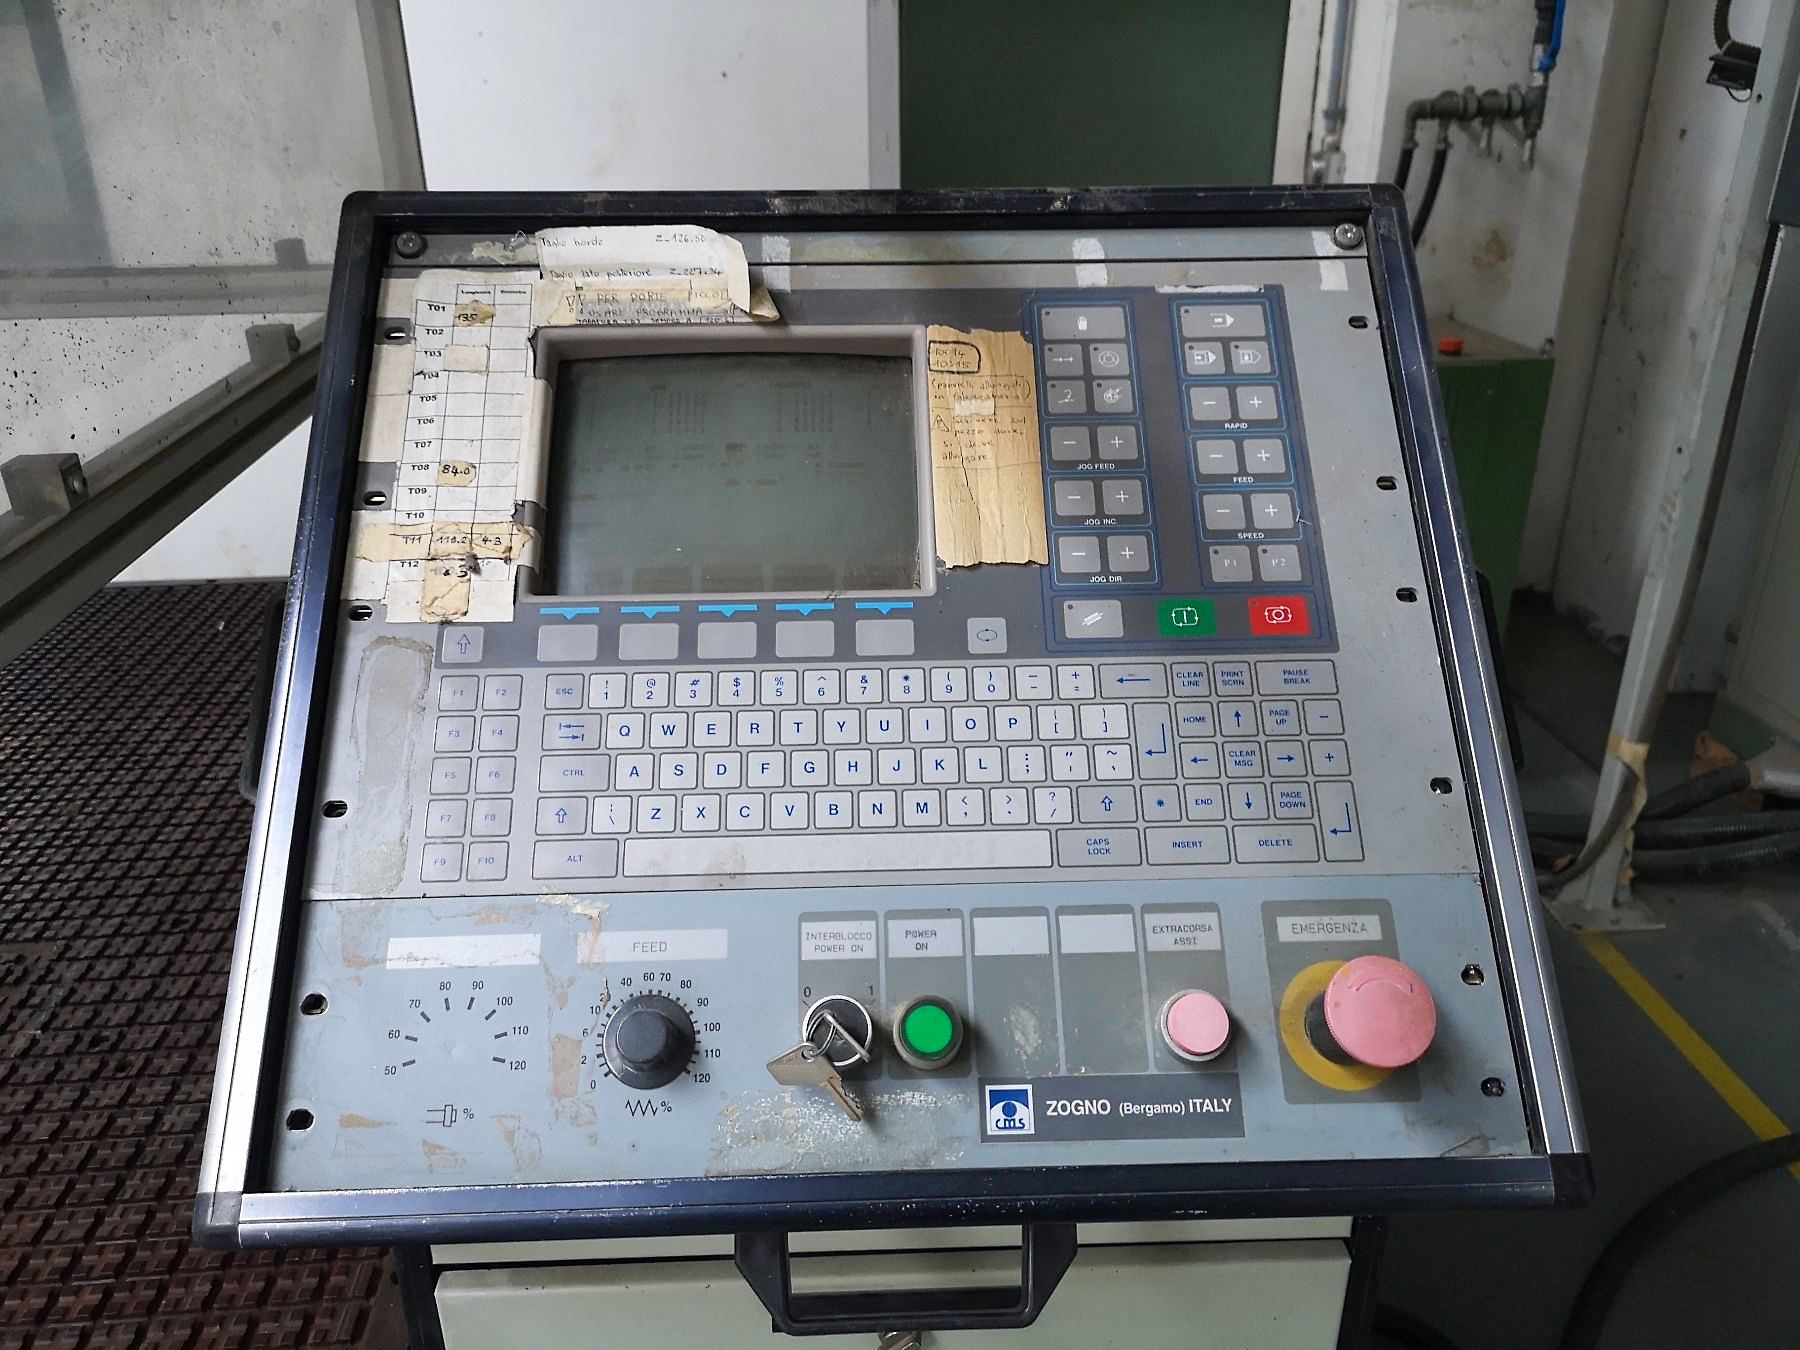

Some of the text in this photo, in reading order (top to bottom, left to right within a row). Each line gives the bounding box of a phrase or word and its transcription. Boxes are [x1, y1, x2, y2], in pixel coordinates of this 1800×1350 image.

[597, 292, 618, 303] PER
[427, 303, 446, 312] T01
[424, 328, 444, 336] T02
[419, 394, 438, 403] T05
[416, 417, 435, 425] T06
[1224, 422, 1248, 430] RAPID
[414, 440, 433, 449] T07
[410, 463, 430, 471] T08
[1094, 462, 1115, 470] FEED
[1233, 476, 1254, 484] FEED
[407, 487, 427, 495] T09
[405, 511, 425, 520] T10
[1084, 518, 1101, 526] JOG
[1237, 532, 1265, 541] SPEED
[400, 560, 419, 568] T12
[1089, 575, 1122, 583] JOG DIR
[1176, 671, 1204, 679] CLEAR
[1220, 670, 1244, 678] PRINT
[1282, 669, 1308, 677] PAUSE
[1182, 679, 1201, 687] LINE
[1221, 678, 1245, 687] SCRN
[1283, 677, 1311, 685] BREAK
[495, 687, 508, 697] F2
[555, 687, 574, 695] ESC
[689, 689, 697, 699] 3
[732, 688, 740, 698] 4
[775, 687, 783, 697] 5
[817, 687, 825, 697] 6
[860, 686, 868, 695] 7
[903, 685, 911, 695] 8
[945, 684, 953, 694] 9
[603, 690, 610, 701] 1
[646, 690, 654, 700] 2
[1268, 709, 1290, 717] PAGE
[925, 719, 929, 730] I
[965, 718, 977, 730] O
[1008, 717, 1018, 729] P
[1183, 716, 1207, 724] HOME
[1275, 717, 1287, 725] UP
[618, 724, 631, 737] Q
[661, 724, 676, 736] W
[707, 723, 717, 735] E
[750, 722, 760, 734] R
[793, 721, 804, 734] T
[836, 720, 846, 733] Y
[879, 719, 890, 732] U
[448, 729, 460, 738] F3
[491, 729, 503, 737] F4
[1228, 749, 1256, 758] CLEAR
[803, 761, 815, 774] G
[848, 760, 858, 773] H
[892, 759, 901, 772] J
[934, 759, 945, 771] K
[978, 758, 988, 770] L
[1234, 759, 1254, 767] MSG
[562, 769, 585, 777] CTRL
[629, 765, 640, 778] A
[673, 764, 684, 777] S
[716, 763, 727, 776] D
[761, 762, 770, 775] F
[444, 771, 457, 780] F5
[488, 770, 501, 779] F6
[1280, 791, 1302, 799] PAGE
[1194, 798, 1213, 806] END
[1279, 801, 1306, 809] DOWN
[696, 806, 706, 819] X
[739, 805, 751, 818] C
[784, 804, 795, 817] V
[828, 803, 839, 816] B
[872, 802, 883, 815] N
[916, 801, 929, 814] M
[440, 814, 452, 823] F7
[484, 813, 496, 822] F8
[650, 808, 662, 820] Z
[1086, 838, 1110, 846] CAPS
[1172, 840, 1202, 849] INSERT
[1258, 838, 1293, 847] DELETE
[1087, 847, 1111, 856] LOCK
[433, 857, 447, 867] F9
[566, 854, 583, 863] ALT
[1152, 923, 1213, 935] EXTRACORSA
[1291, 921, 1368, 935] EMERGENZA
[806, 931, 873, 941] INTERBLOCCO
[905, 929, 937, 939] POWER
[1173, 936, 1197, 946] ASSI
[632, 941, 668, 953] FEED
[814, 943, 864, 953] POWER ON
[915, 942, 928, 951] ON
[643, 971, 655, 982] 60
[659, 972, 672, 982] 70
[439, 981, 452, 991] 80
[472, 980, 484, 990] 90
[620, 977, 633, 987] 40
[680, 979, 692, 989] 80
[803, 986, 812, 998] 0
[868, 984, 874, 996] 1
[409, 999, 421, 1009] 70
[496, 996, 513, 1006] 100
[696, 997, 709, 1007] 90
[590, 1005, 601, 1015] 10
[512, 1025, 529, 1036] 110
[582, 1027, 589, 1037] 6
[703, 1022, 721, 1032] 100
[388, 1029, 401, 1039] 60
[704, 1048, 721, 1059] 110
[580, 1055, 587, 1065] 2
[384, 1065, 397, 1076] 50
[509, 1060, 527, 1071] 120
[692, 1072, 711, 1083] 120
[590, 1079, 597, 1090] 0
[660, 1100, 673, 1113] %
[1046, 1098, 1232, 1118] ZOGNO (Bergamo) ITALY
[462, 1107, 475, 1120] %
